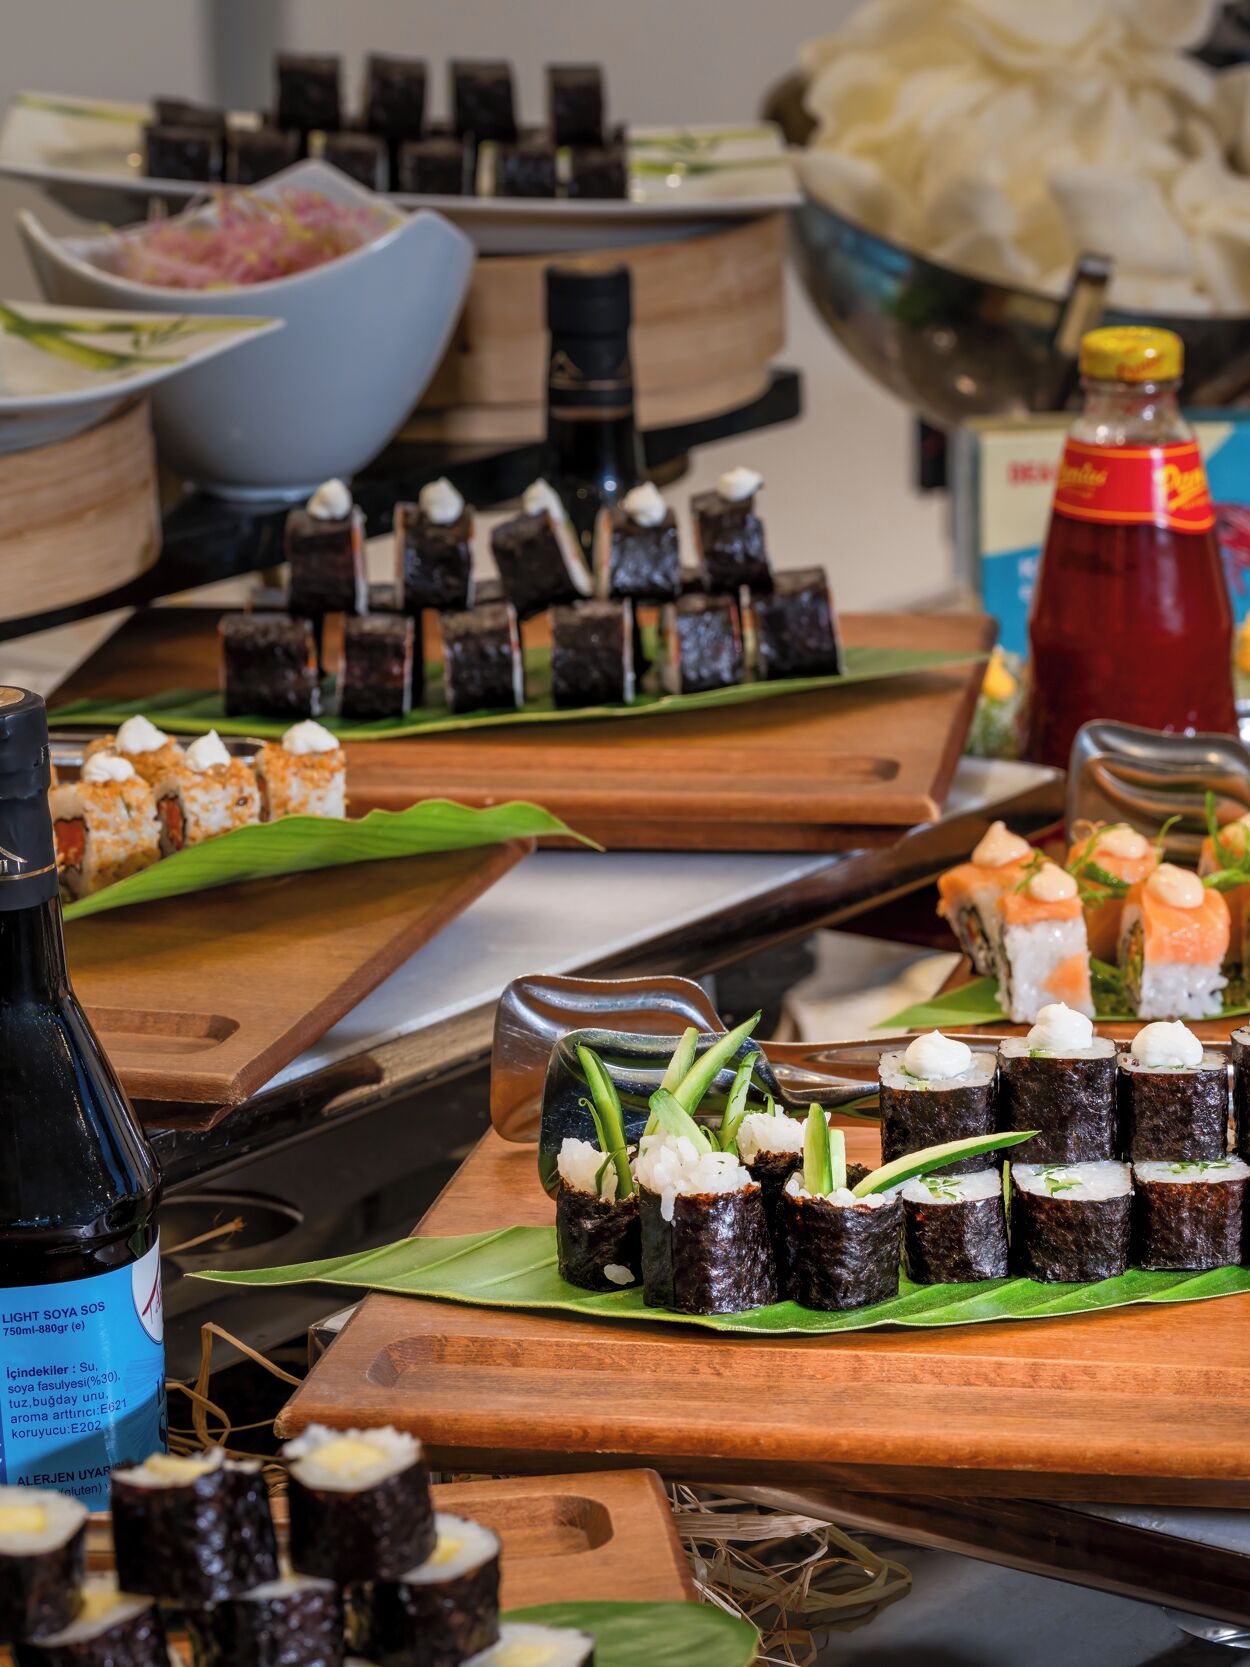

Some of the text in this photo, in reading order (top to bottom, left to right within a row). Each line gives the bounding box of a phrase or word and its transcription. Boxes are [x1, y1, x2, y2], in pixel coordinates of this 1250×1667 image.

[2, 1301, 105, 1323] LIGHT SOYA SOS
[3, 1320, 85, 1336] 750ml-880gr (e)
[8, 1384, 35, 1395] soya
[10, 1412, 48, 1424] aroma
[11, 1420, 101, 1439] koruyucu:E202
[17, 1471, 75, 1487] ALERJEN
